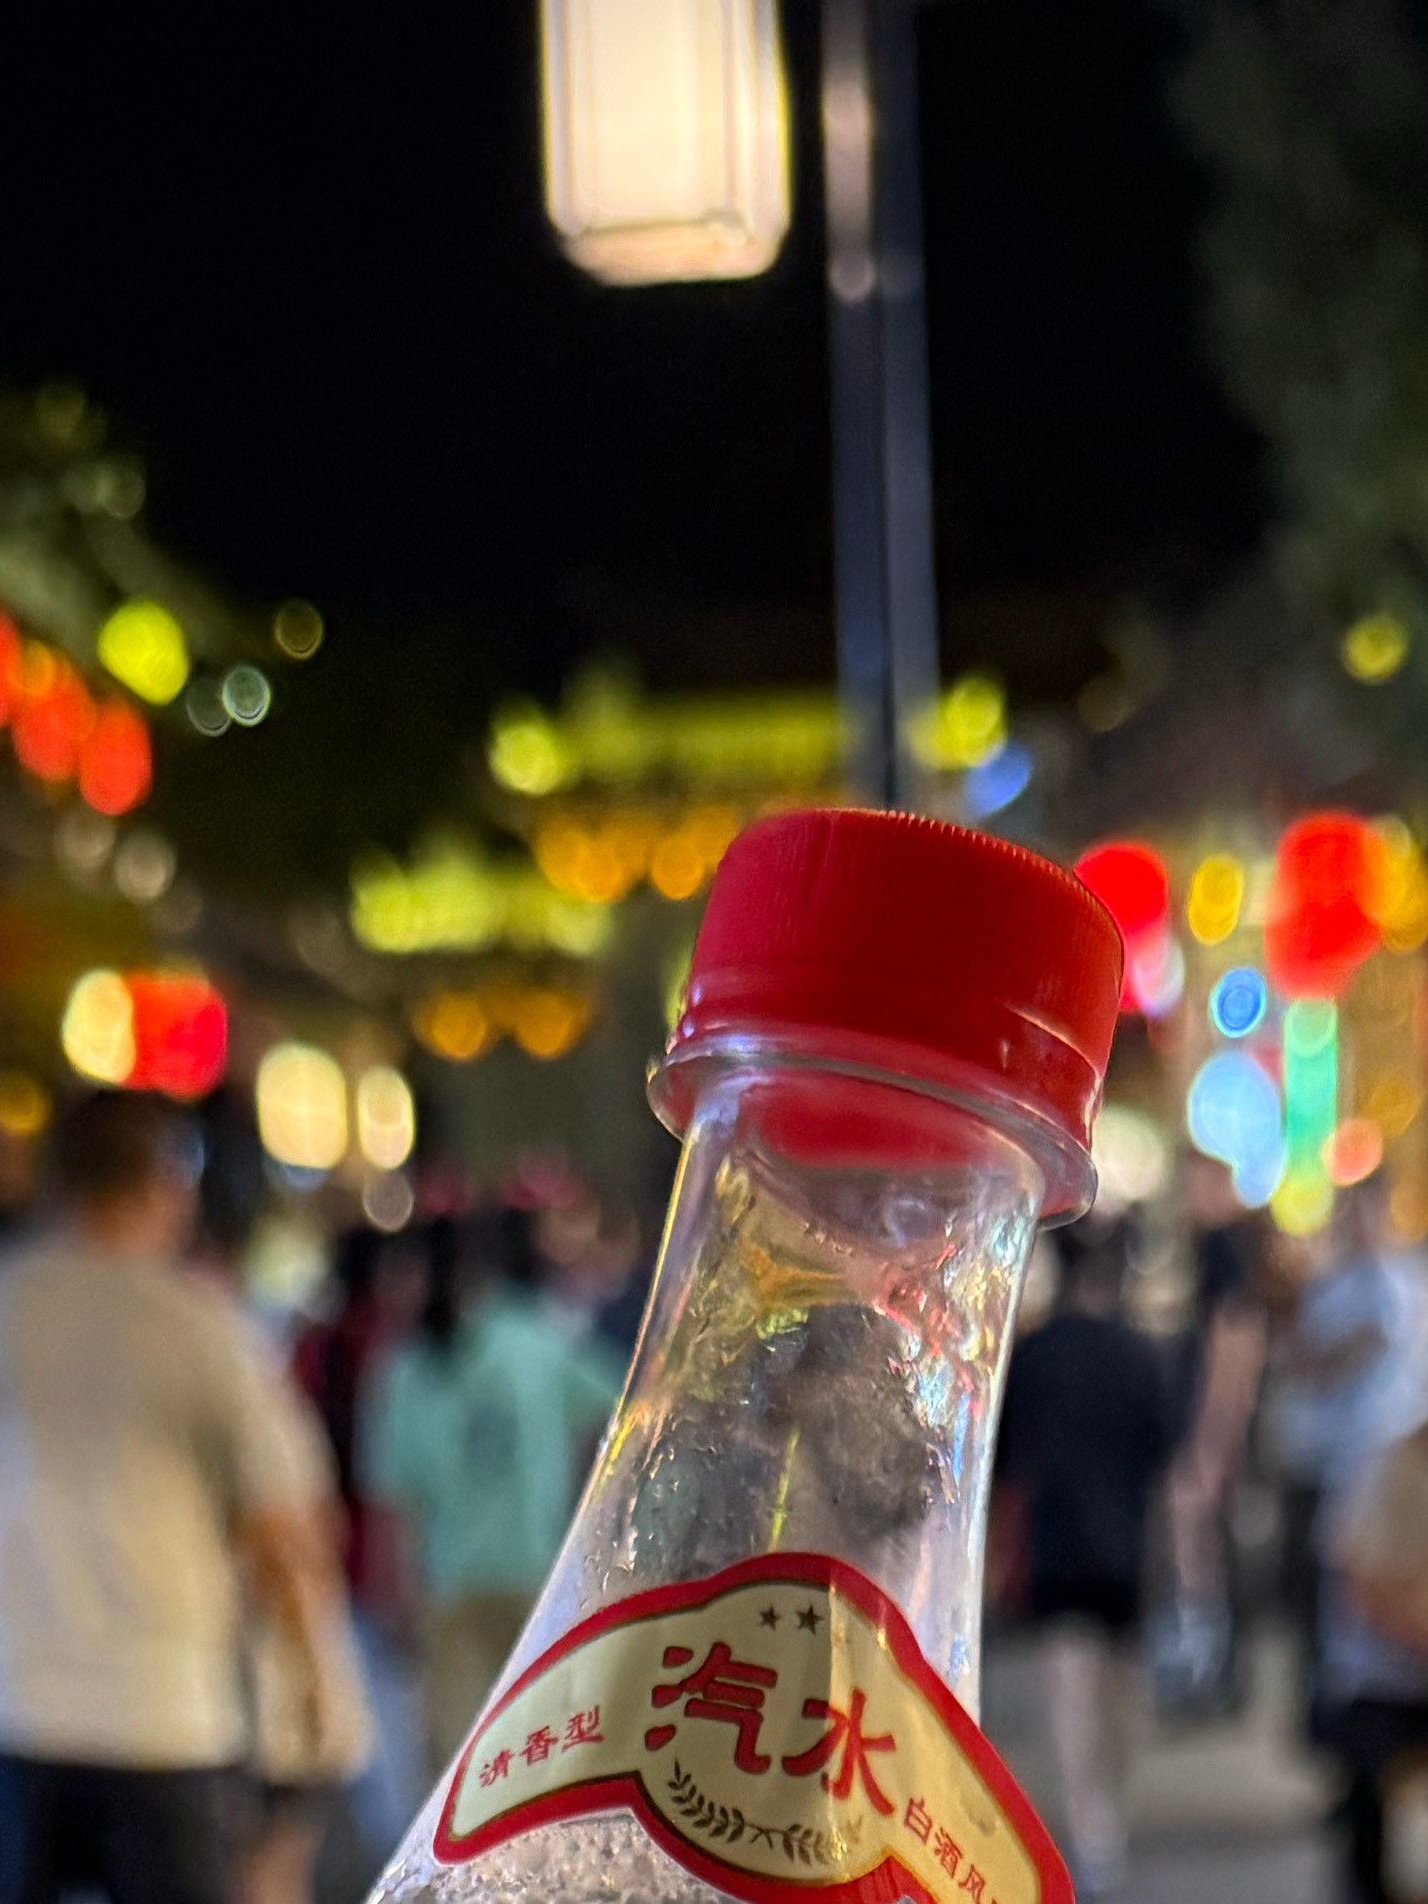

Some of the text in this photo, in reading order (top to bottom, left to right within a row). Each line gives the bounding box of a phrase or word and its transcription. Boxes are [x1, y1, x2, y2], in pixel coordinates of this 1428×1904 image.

[479, 1705, 606, 1788] 清香型
[644, 1641, 896, 1818] 汽水
